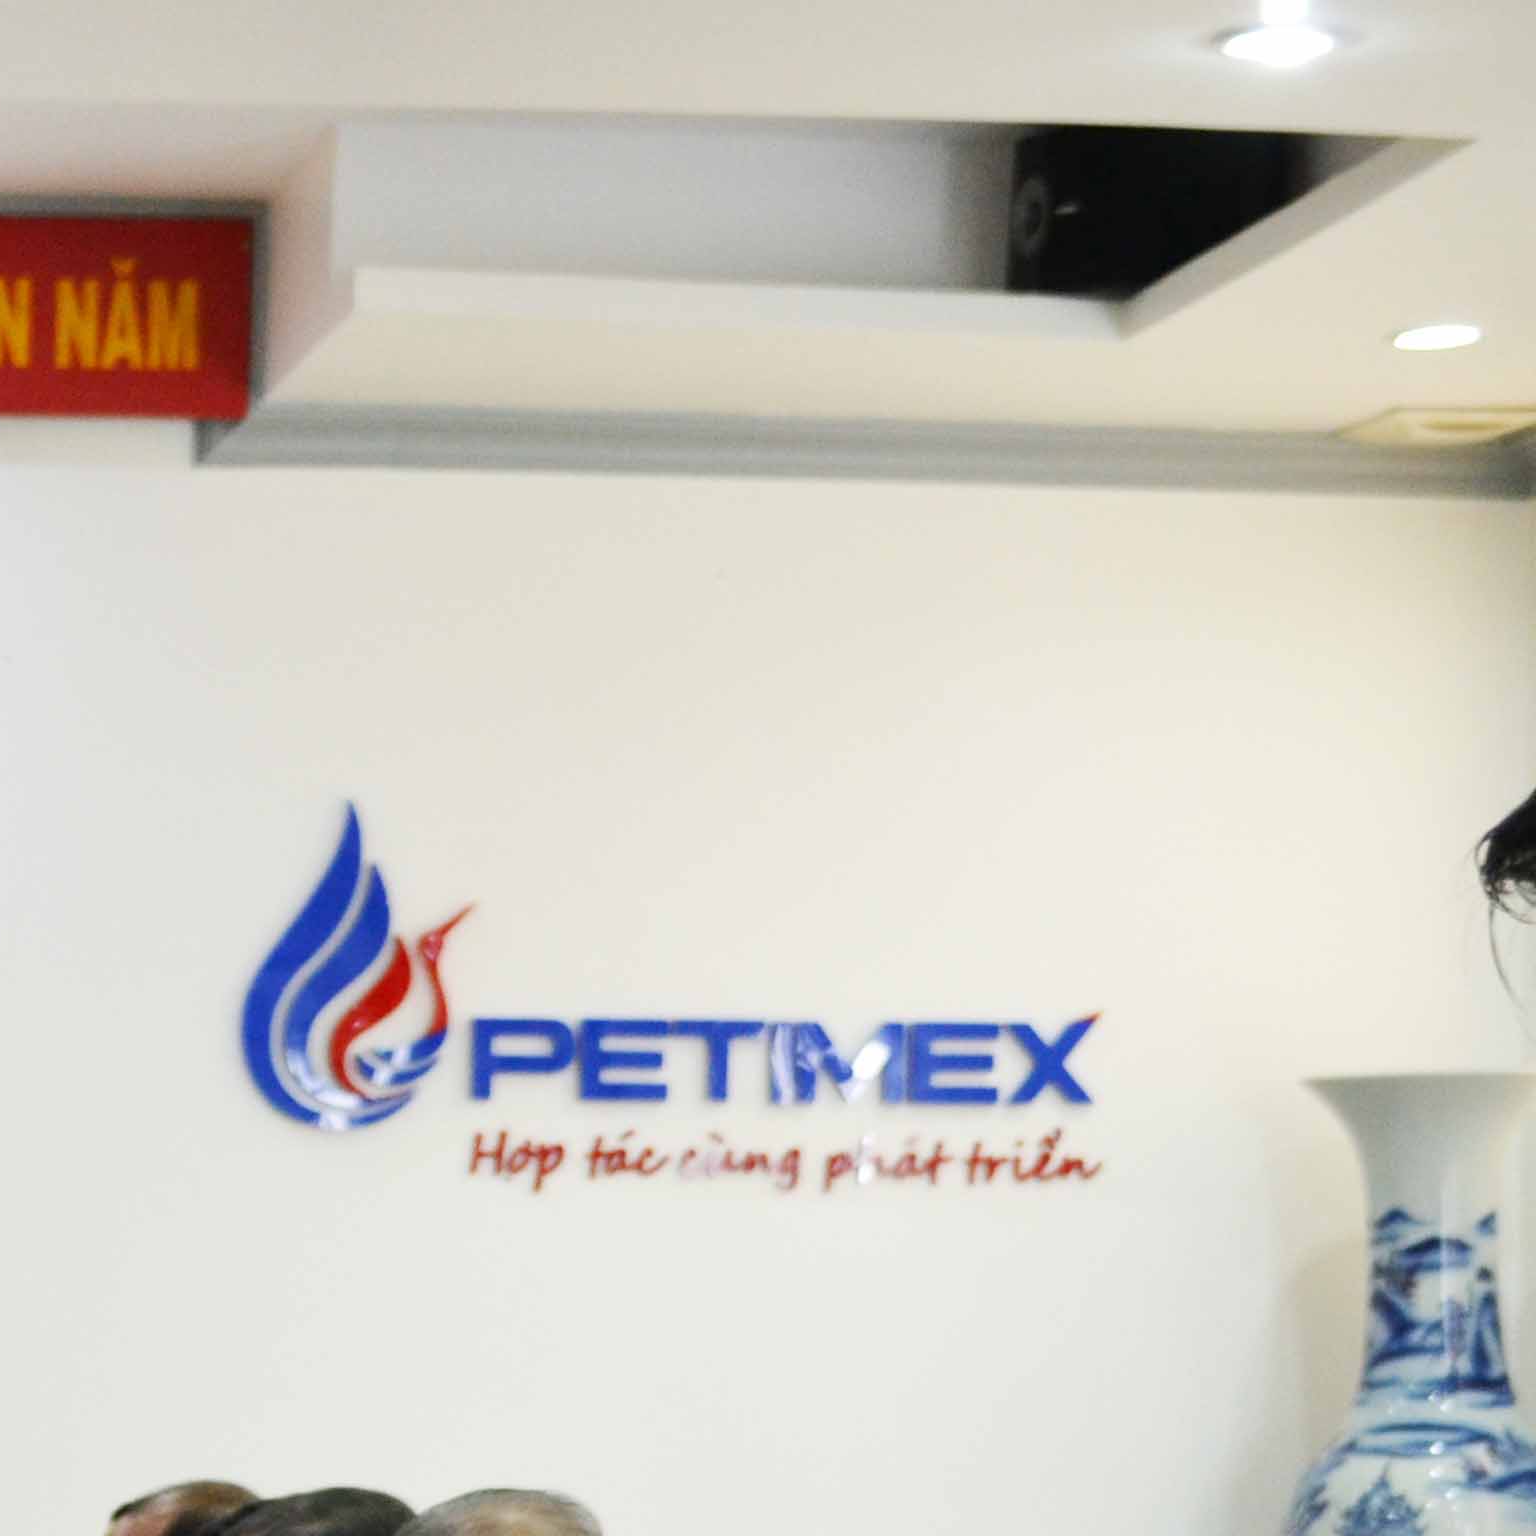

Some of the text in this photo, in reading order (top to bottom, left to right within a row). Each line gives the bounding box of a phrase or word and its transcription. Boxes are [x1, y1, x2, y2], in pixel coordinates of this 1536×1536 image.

[54, 255, 199, 372] NĂM
[471, 1011, 1103, 1103] PETIMEX
[584, 1129, 669, 1180] tác
[680, 1130, 801, 1191] cùng
[963, 1128, 1102, 1186] triển
